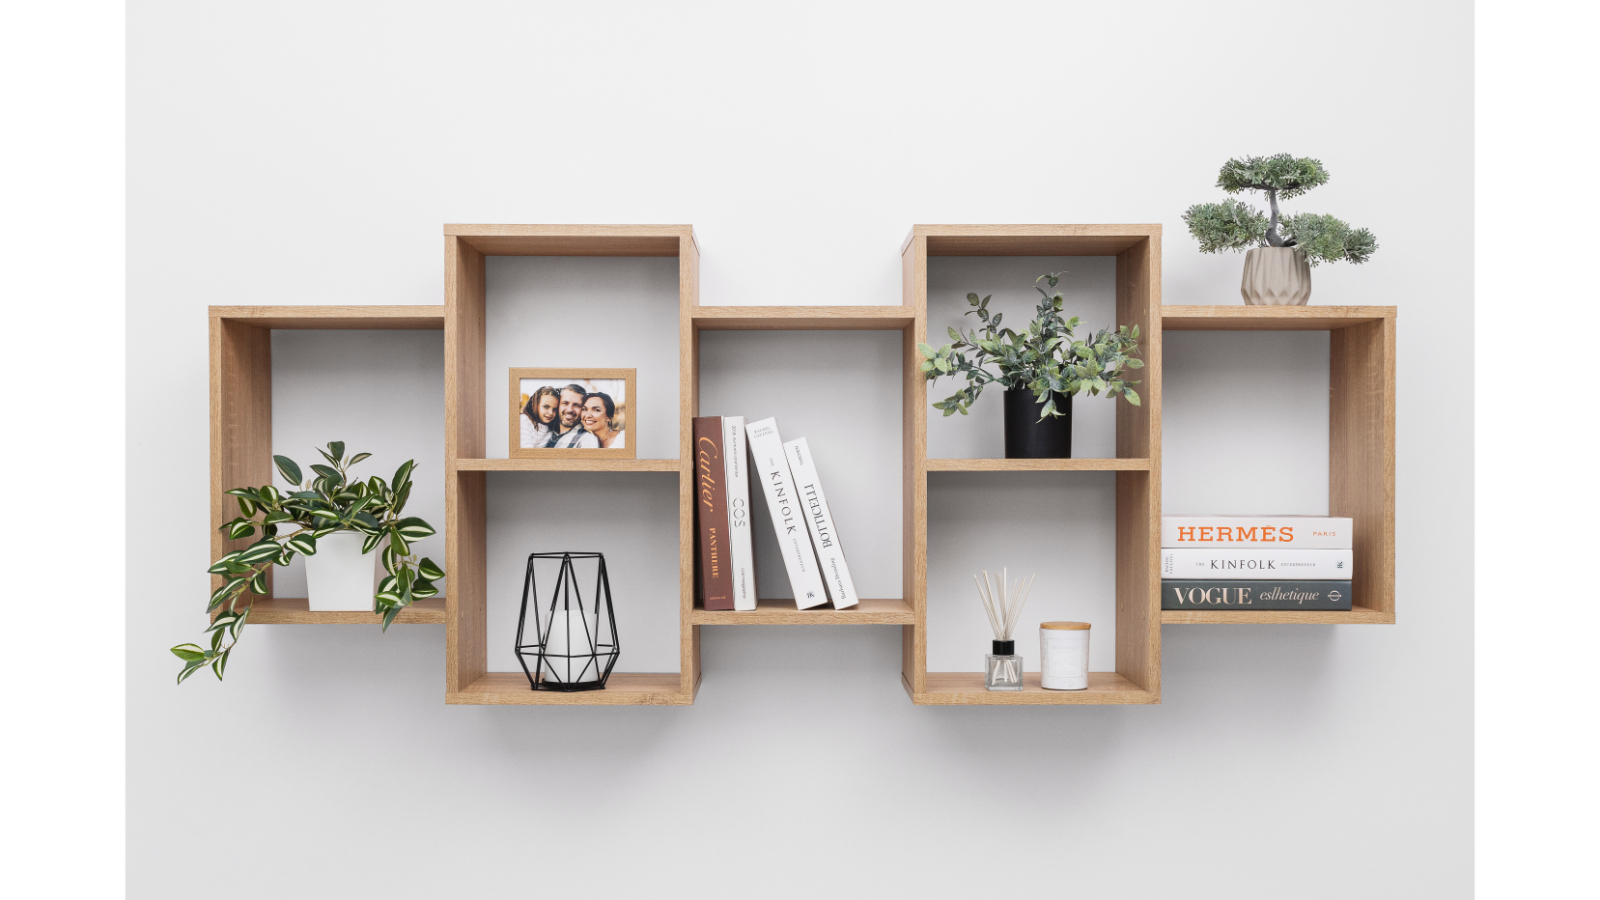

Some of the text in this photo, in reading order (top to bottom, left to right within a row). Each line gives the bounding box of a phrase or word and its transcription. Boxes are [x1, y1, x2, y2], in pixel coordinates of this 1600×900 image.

[698, 436, 718, 513] Cartier
[732, 497, 747, 528] COS
[770, 470, 798, 535] KINFOLK
[804, 483, 833, 549] BOTTICELLI
[1210, 559, 1276, 570] KINFOLK
[1173, 587, 1253, 606] VOGUE
